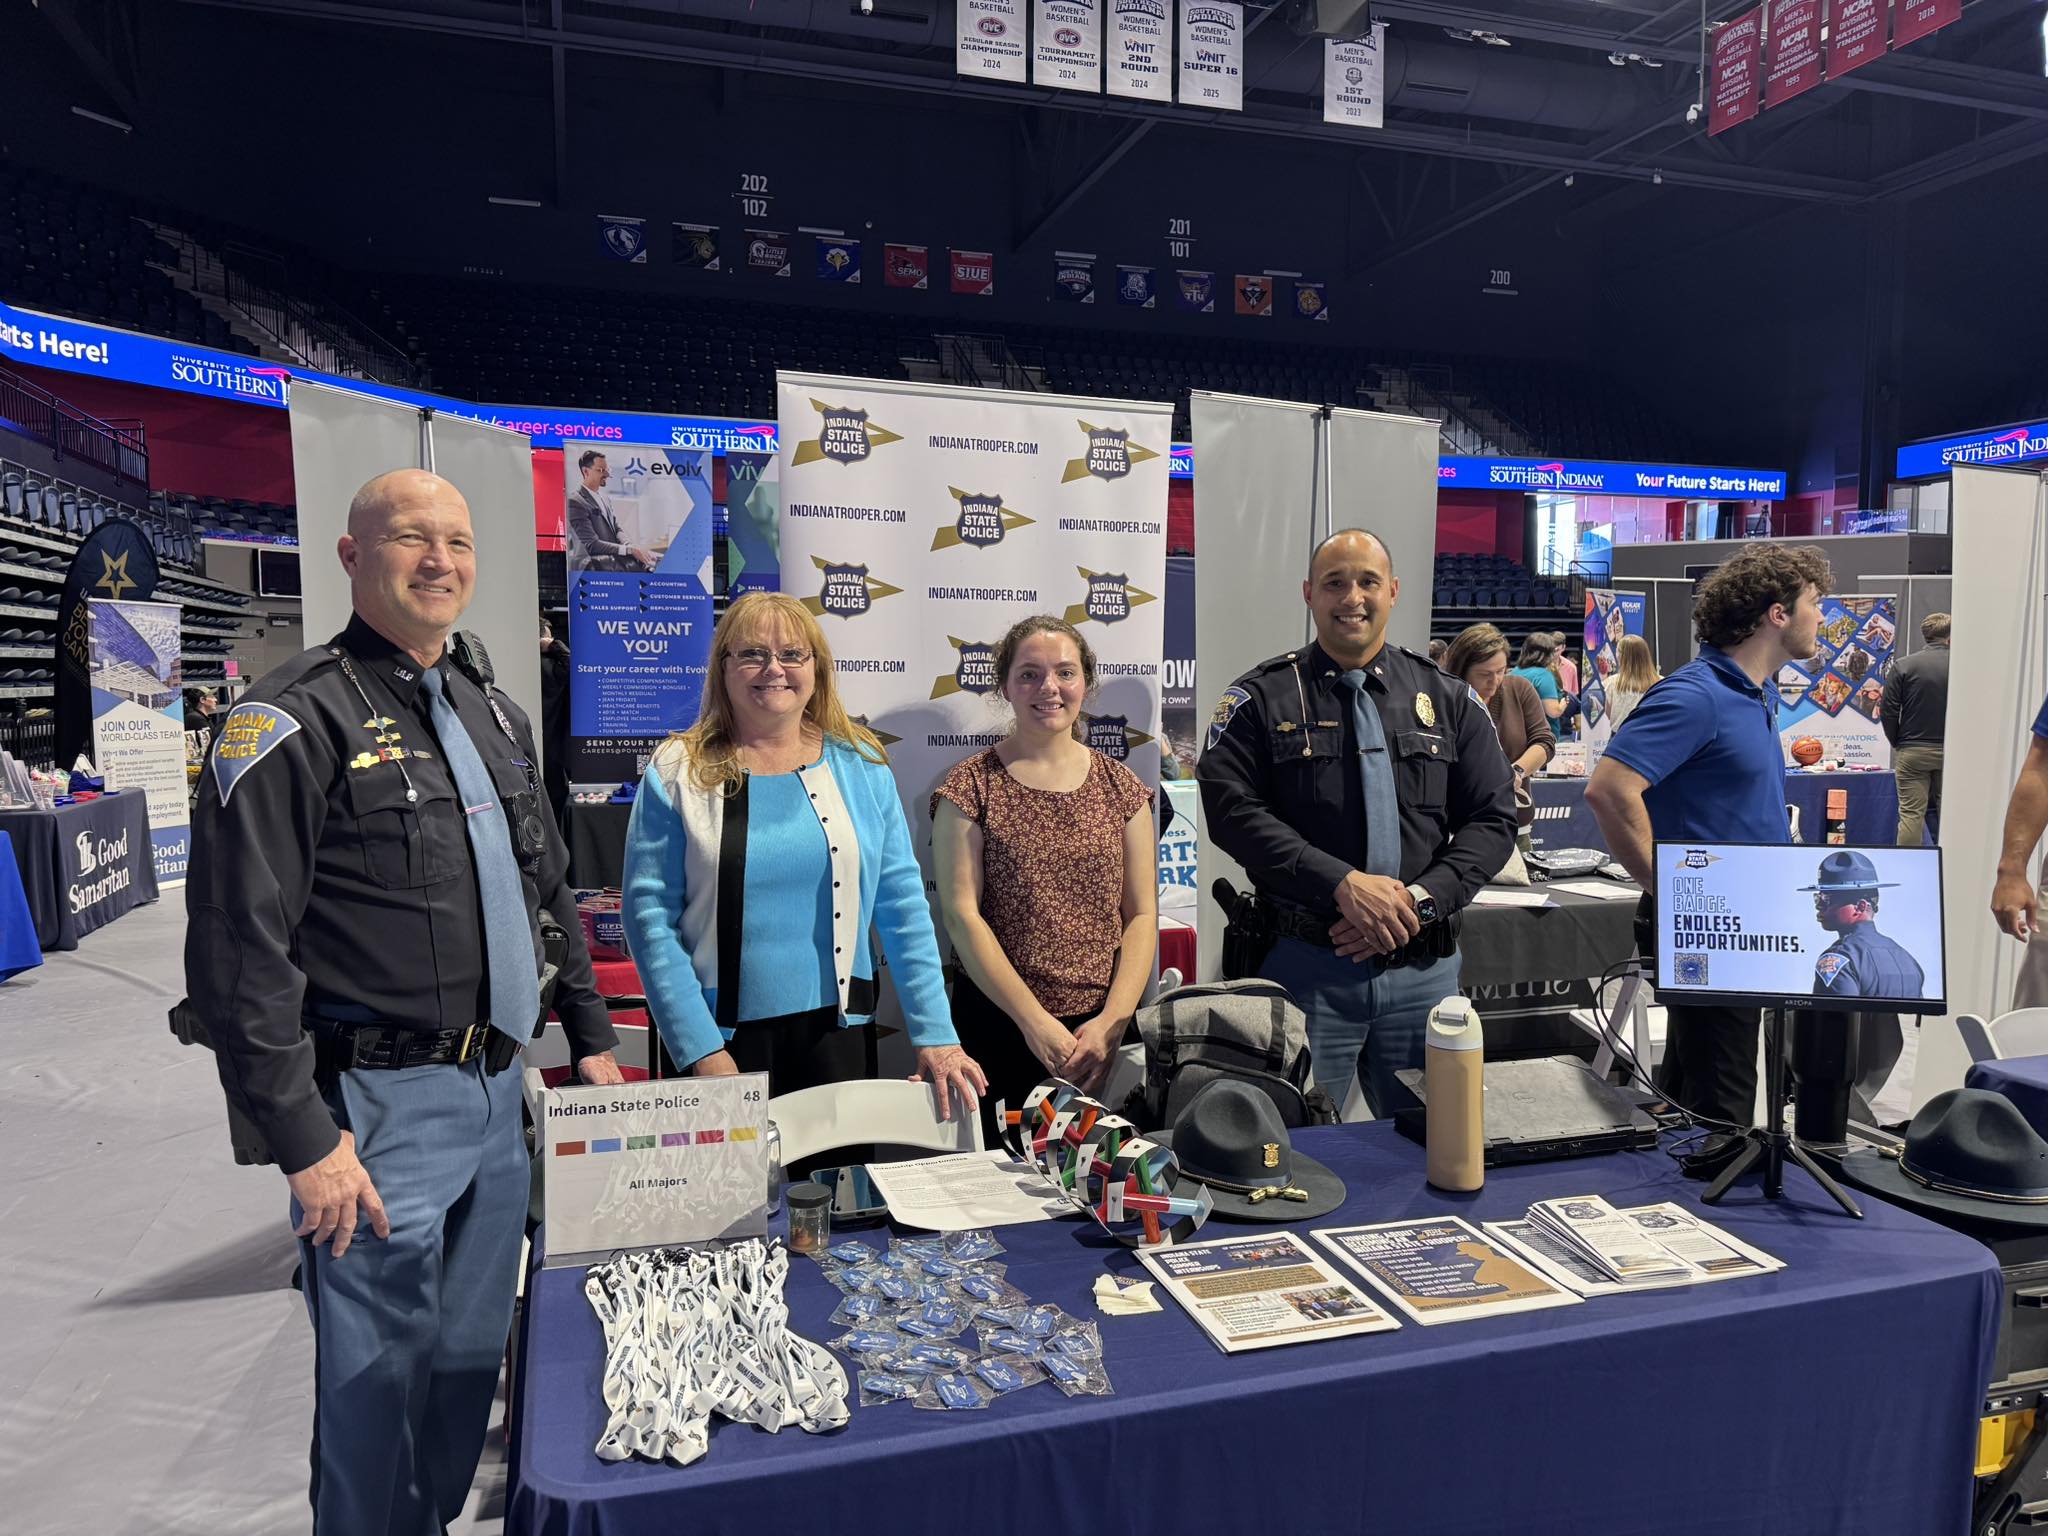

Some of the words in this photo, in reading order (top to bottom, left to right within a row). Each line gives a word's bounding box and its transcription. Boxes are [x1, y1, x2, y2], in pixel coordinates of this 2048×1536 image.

[970, 2, 1014, 14] BASKETBALL
[1051, 5, 1085, 15] WOMEN'S
[1046, 13, 1089, 25] BASKETBALL
[1123, 15, 1157, 26] WOMEN'S
[1119, 24, 1160, 35] BASKETBALL
[1195, 25, 1227, 36] WOMEN'S
[1191, 34, 1231, 45] BASKETBALL
[961, 44, 1022, 56] CHAMPIONSHIP
[1040, 47, 1095, 59] TOURNAMENT
[983, 59, 1001, 69] 2024
[1037, 55, 1097, 67] CHAMPIONSHIP
[1128, 54, 1151, 63] 2ND
[1335, 54, 1373, 66] BASKETBALL
[1121, 62, 1159, 73] ROUND
[1184, 62, 1221, 73] SUPER
[1226, 67, 1238, 75] 16
[1058, 70, 1076, 79] 2024
[1345, 87, 1363, 95] 1ST
[1336, 94, 1371, 104] ROUND
[741, 173, 769, 193] 202
[742, 198, 768, 217] 102
[1169, 218, 1190, 235] 201
[1169, 241, 1190, 258] 101
[956, 266, 989, 281] SIUE
[1490, 269, 1510, 285] 200
[40, 330, 109, 364] Here!
[172, 355, 230, 371] UNIVERSITY
[172, 363, 277, 397] SOUTHERN
[826, 417, 864, 431] INDIANA
[671, 431, 761, 450] SOUTHERN
[827, 429, 862, 443] STATE
[824, 441, 866, 455] POLICE
[928, 435, 1038, 455] INDIANATROOPER.COM
[1091, 437, 1125, 450] INDIANA
[1092, 448, 1123, 460] STATE
[1941, 442, 2015, 465] SOUTHERN
[651, 460, 702, 477] evolv
[1090, 459, 1126, 472] POLICE
[1490, 469, 1552, 485] SOUTHERN
[1554, 470, 1604, 489] INDIANA
[1636, 473, 1664, 488] Your
[1667, 474, 1706, 489] Future
[1709, 475, 1746, 491] Starts
[1749, 478, 1780, 492] Here!
[789, 503, 906, 523] INDIANATROOPER.COM
[963, 503, 999, 516] INDIANA
[964, 514, 997, 527] STATE
[1059, 518, 1160, 535] INDIANATROOPER.COM
[961, 526, 1000, 539] POLICE
[827, 573, 864, 586] INDIANA
[828, 585, 863, 597] STATE
[928, 587, 1037, 602] INDIANATROOPER.COM
[1091, 582, 1124, 594] INDIANA
[825, 596, 866, 609] POLICE
[1092, 593, 1123, 605] STATE
[1089, 604, 1126, 616] POLICE
[597, 620, 629, 635] WE
[633, 621, 692, 636] WANT
[622, 639, 668, 654] YOU!
[577, 664, 602, 673] Start
[604, 666, 627, 675] your
[628, 666, 660, 674] career
[661, 665, 683, 674] with
[834, 660, 905, 673] TROOPER.COM
[1097, 663, 1158, 676] TROOPER.COM
[101, 721, 126, 732] JOIN
[128, 720, 151, 731] OUR
[101, 731, 159, 743] WORLD-CLASS
[225, 728, 262, 742] STATE
[1091, 735, 1122, 746] STATE
[216, 742, 257, 759] POLICE
[98, 827, 128, 866] Good
[69, 867, 130, 914] Samaritan
[1673, 876, 1704, 895] ONE
[1673, 894, 1732, 914] BADGE.
[1674, 914, 1741, 933] ENDLESS
[1674, 932, 1806, 953] OPPORTUNITIES.
[744, 1090, 760, 1102] 48
[548, 1102, 607, 1117] Indiana
[611, 1099, 650, 1113] State
[655, 1095, 700, 1110] Police
[629, 1179, 645, 1190] All
[647, 1176, 688, 1190] Majors
